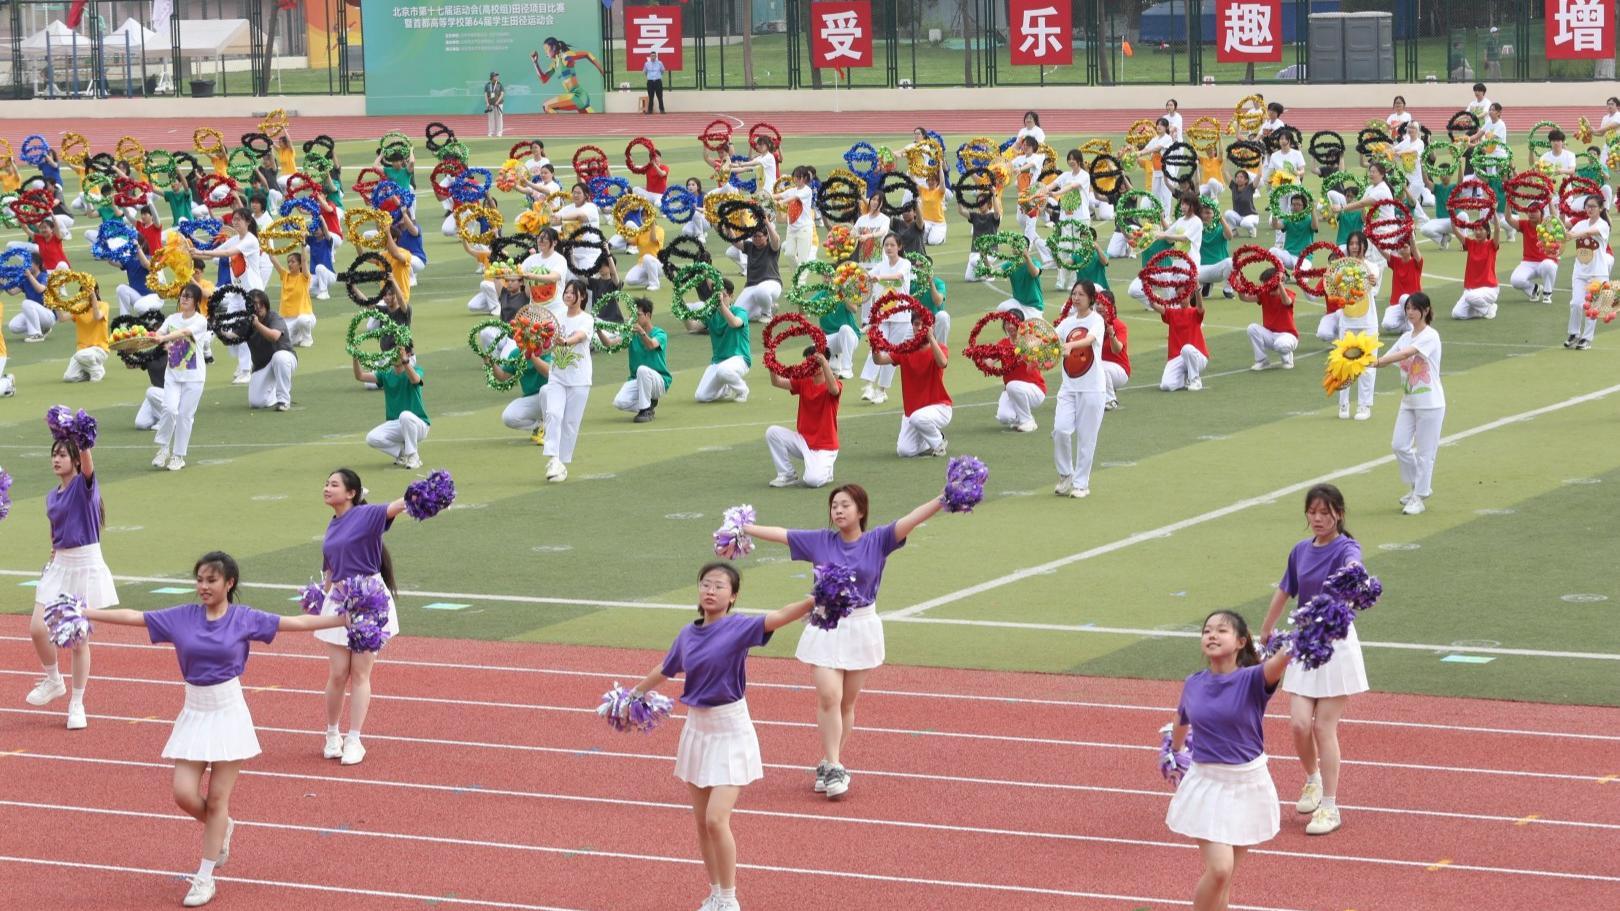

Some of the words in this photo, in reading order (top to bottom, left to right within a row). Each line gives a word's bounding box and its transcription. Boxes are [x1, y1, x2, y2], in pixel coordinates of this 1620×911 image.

[632, 15, 675, 60] 享
[821, 11, 862, 60] 受
[1019, 7, 1062, 57] 乐
[1225, 3, 1273, 53] 趣
[1554, 0, 1604, 51] 增
